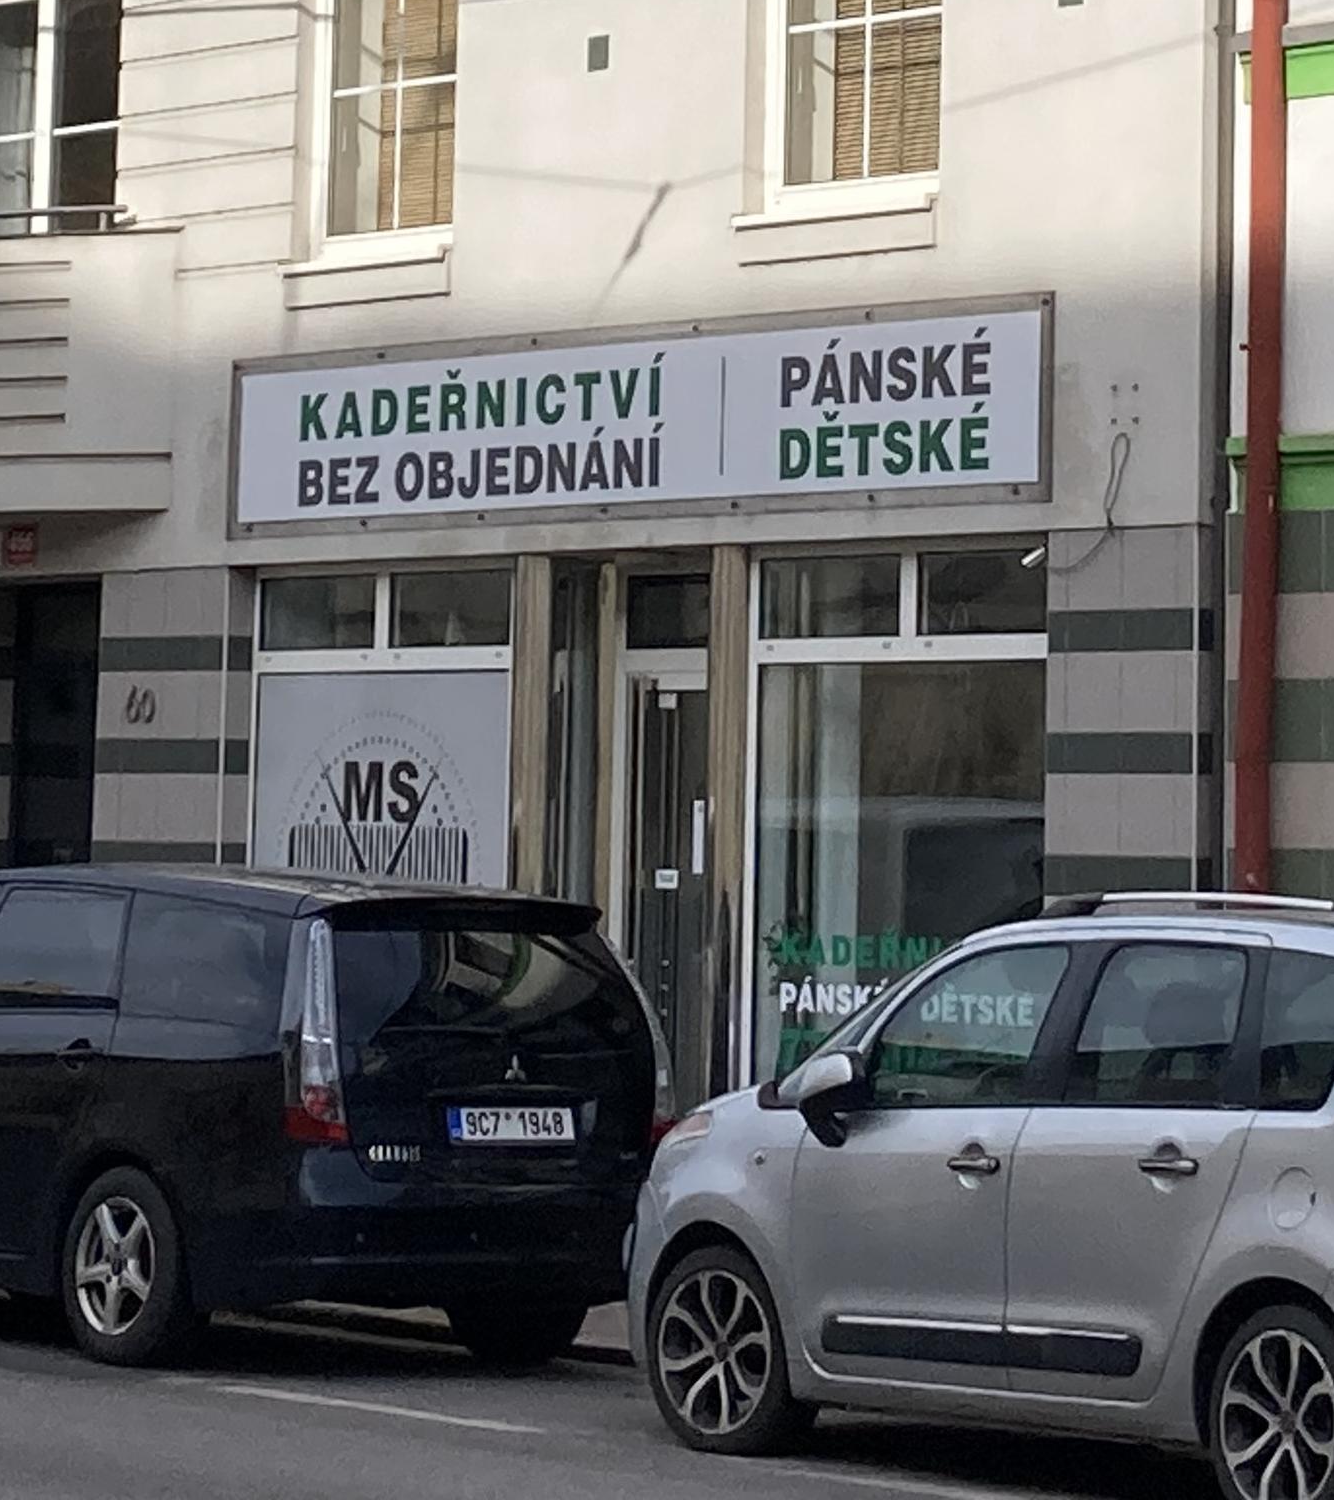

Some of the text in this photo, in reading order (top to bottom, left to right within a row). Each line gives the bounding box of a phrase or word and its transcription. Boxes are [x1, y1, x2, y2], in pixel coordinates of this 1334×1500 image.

[299, 352, 665, 442] KADEŘNICTVÍ
[780, 326, 991, 408] PÁNSKÉ
[297, 422, 665, 508] BEZ OBJEDNÁNÍ
[779, 401, 990, 480] DĚTSKÉ
[126, 684, 156, 724] 60
[342, 759, 420, 824] MS
[466, 1110, 565, 1136] 9C7 1948
